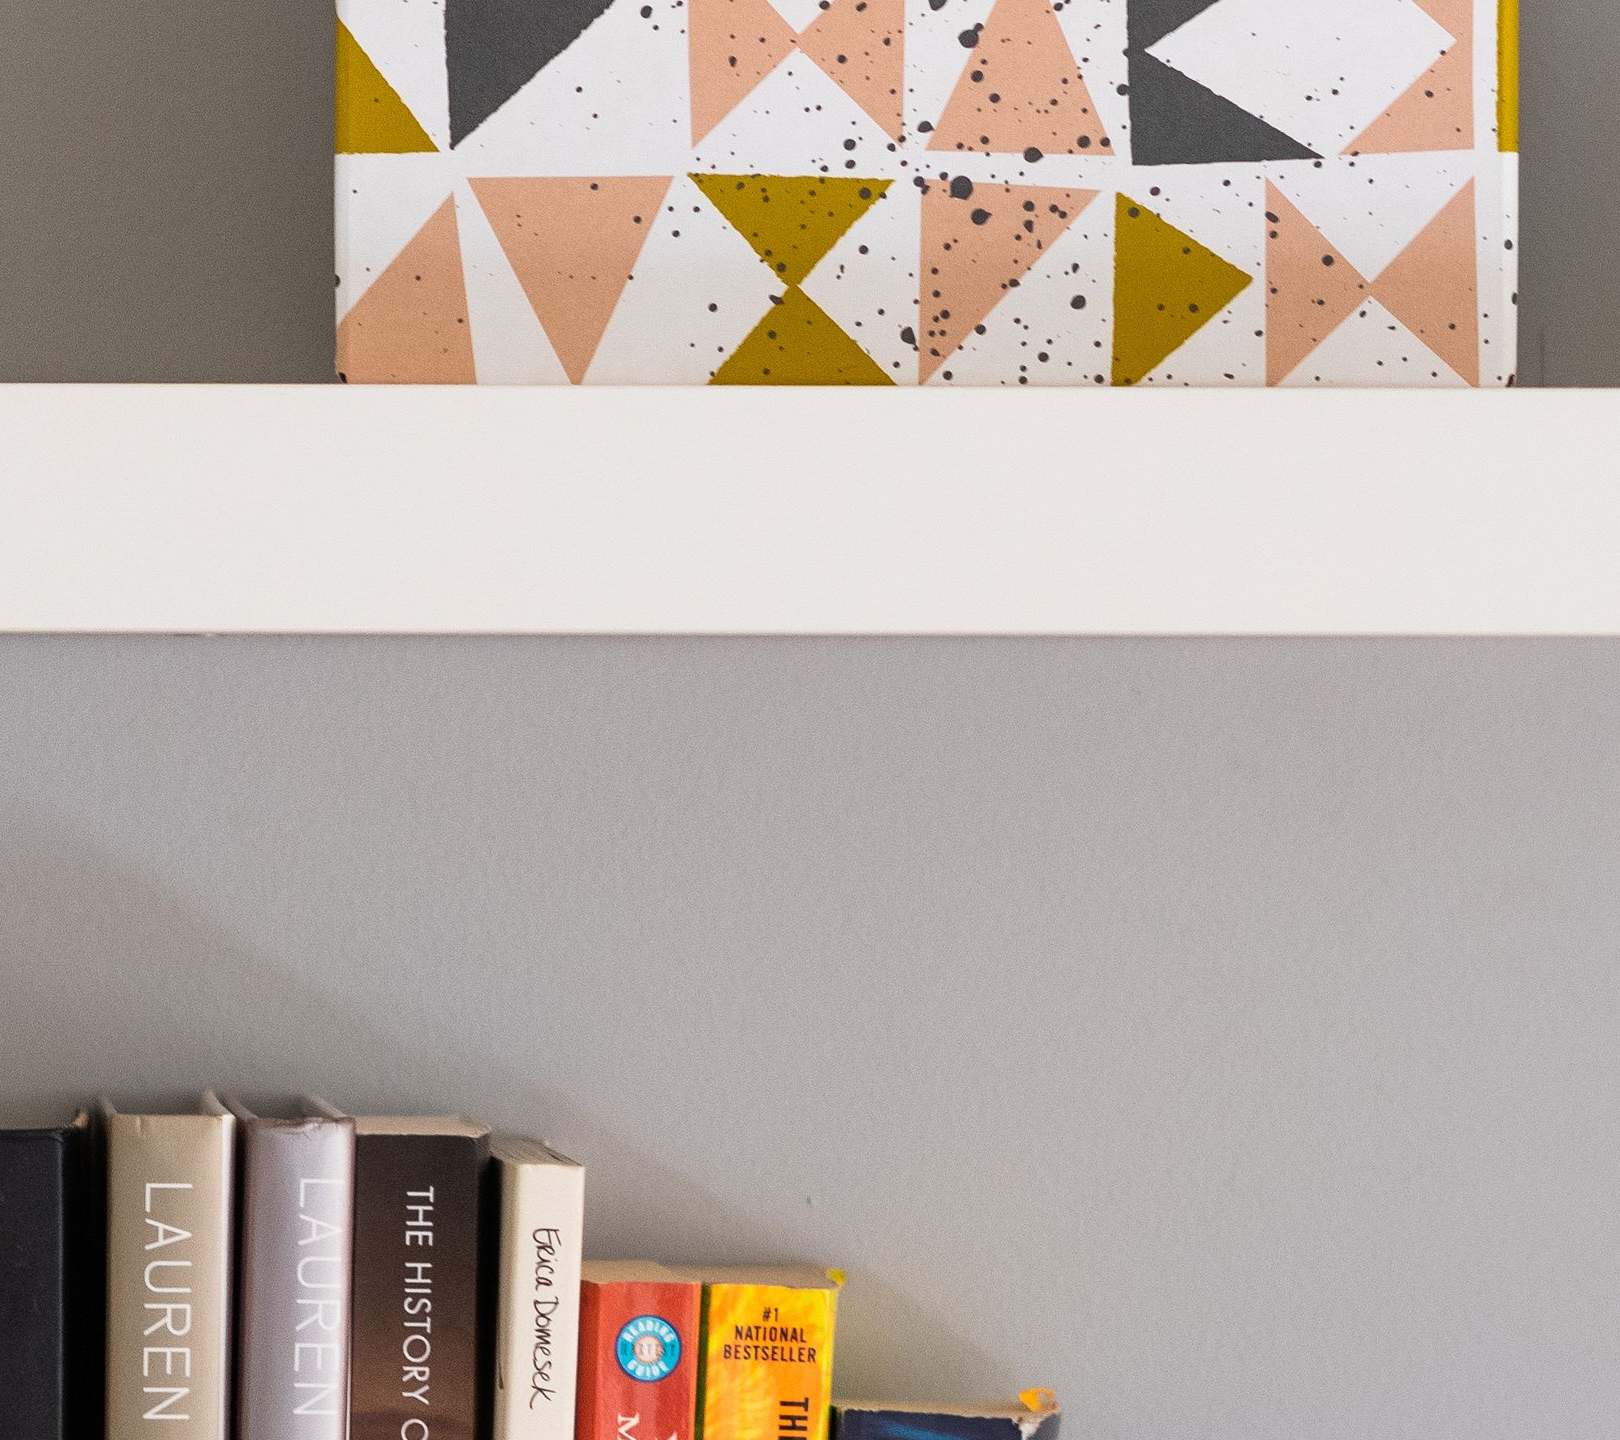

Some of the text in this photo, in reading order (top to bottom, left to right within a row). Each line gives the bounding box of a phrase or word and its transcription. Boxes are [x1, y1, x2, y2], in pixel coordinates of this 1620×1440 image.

[405, 1186, 433, 1247] THE
[142, 1182, 192, 1420] LAUREN
[293, 1178, 345, 1417] LAUREN
[401, 1262, 432, 1405] HISTORY
[528, 1227, 563, 1409] Erica Domesek
[734, 1326, 807, 1344] NATIONAL
[763, 1307, 779, 1322] #1
[723, 1344, 816, 1363] BESTSELLER
